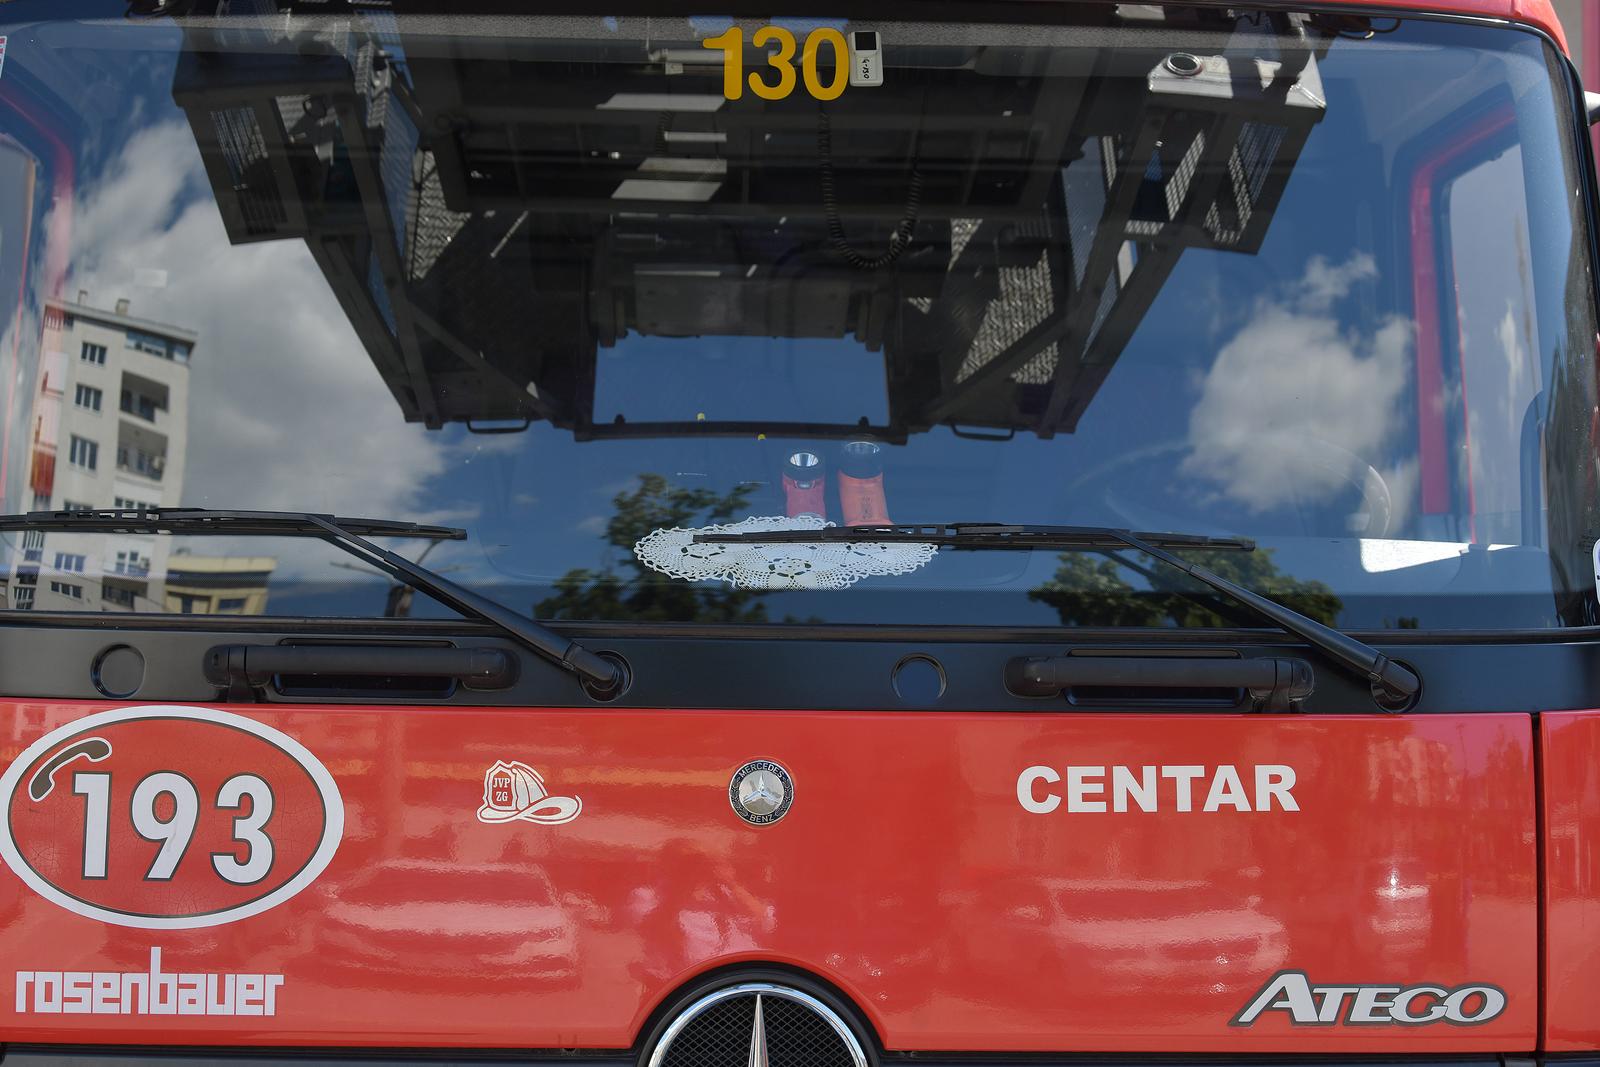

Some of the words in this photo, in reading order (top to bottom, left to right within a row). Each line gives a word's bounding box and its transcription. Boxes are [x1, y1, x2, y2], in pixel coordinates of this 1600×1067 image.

[703, 26, 849, 101] 130
[493, 777, 511, 788] JVP
[739, 762, 785, 778] MERCEDES
[1016, 764, 1300, 814] CENTAR
[495, 791, 509, 802] ZG
[749, 814, 774, 823] BENZ
[72, 769, 275, 886] 193
[15, 946, 285, 1016] rosenbauer
[1230, 969, 1506, 1026] ATEGO
